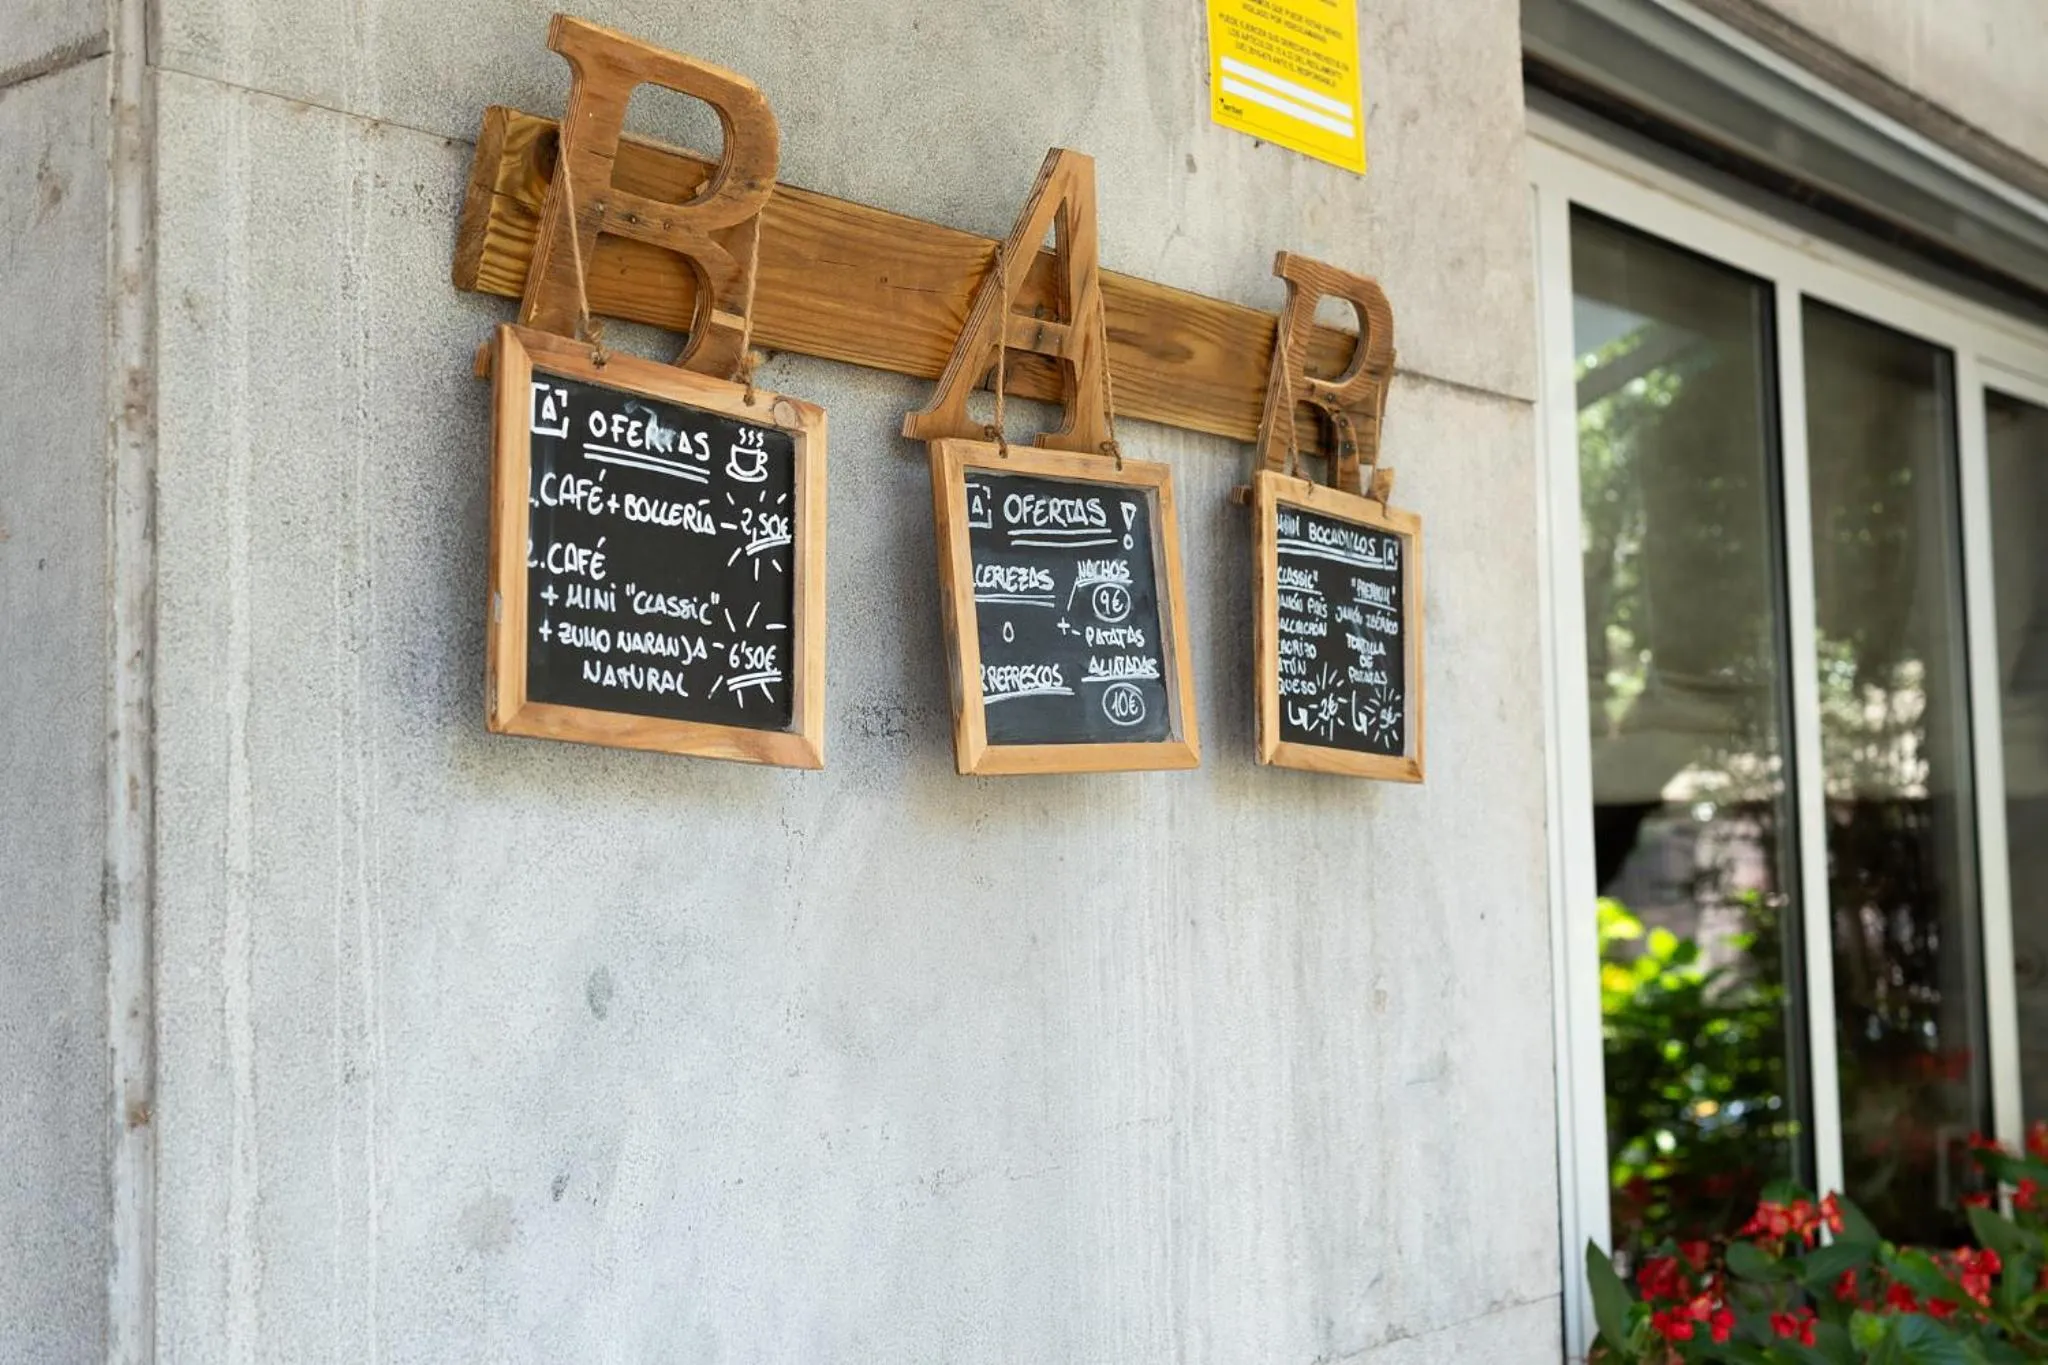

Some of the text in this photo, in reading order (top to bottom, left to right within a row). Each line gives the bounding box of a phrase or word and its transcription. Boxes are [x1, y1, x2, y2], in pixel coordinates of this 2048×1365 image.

[518, 13, 1397, 488] BAR
[588, 410, 711, 462] OFERTAS
[540, 468, 606, 516] CAFÉ
[624, 493, 717, 536] BOLLERÍA
[1003, 493, 1107, 527] OFERTAS
[547, 536, 606, 580] CAFÉ
[558, 622, 611, 653] ZUMO
[616, 630, 708, 666] NARANJA
[1085, 625, 1145, 649] PATATAS
[583, 660, 689, 697] NATURAL
